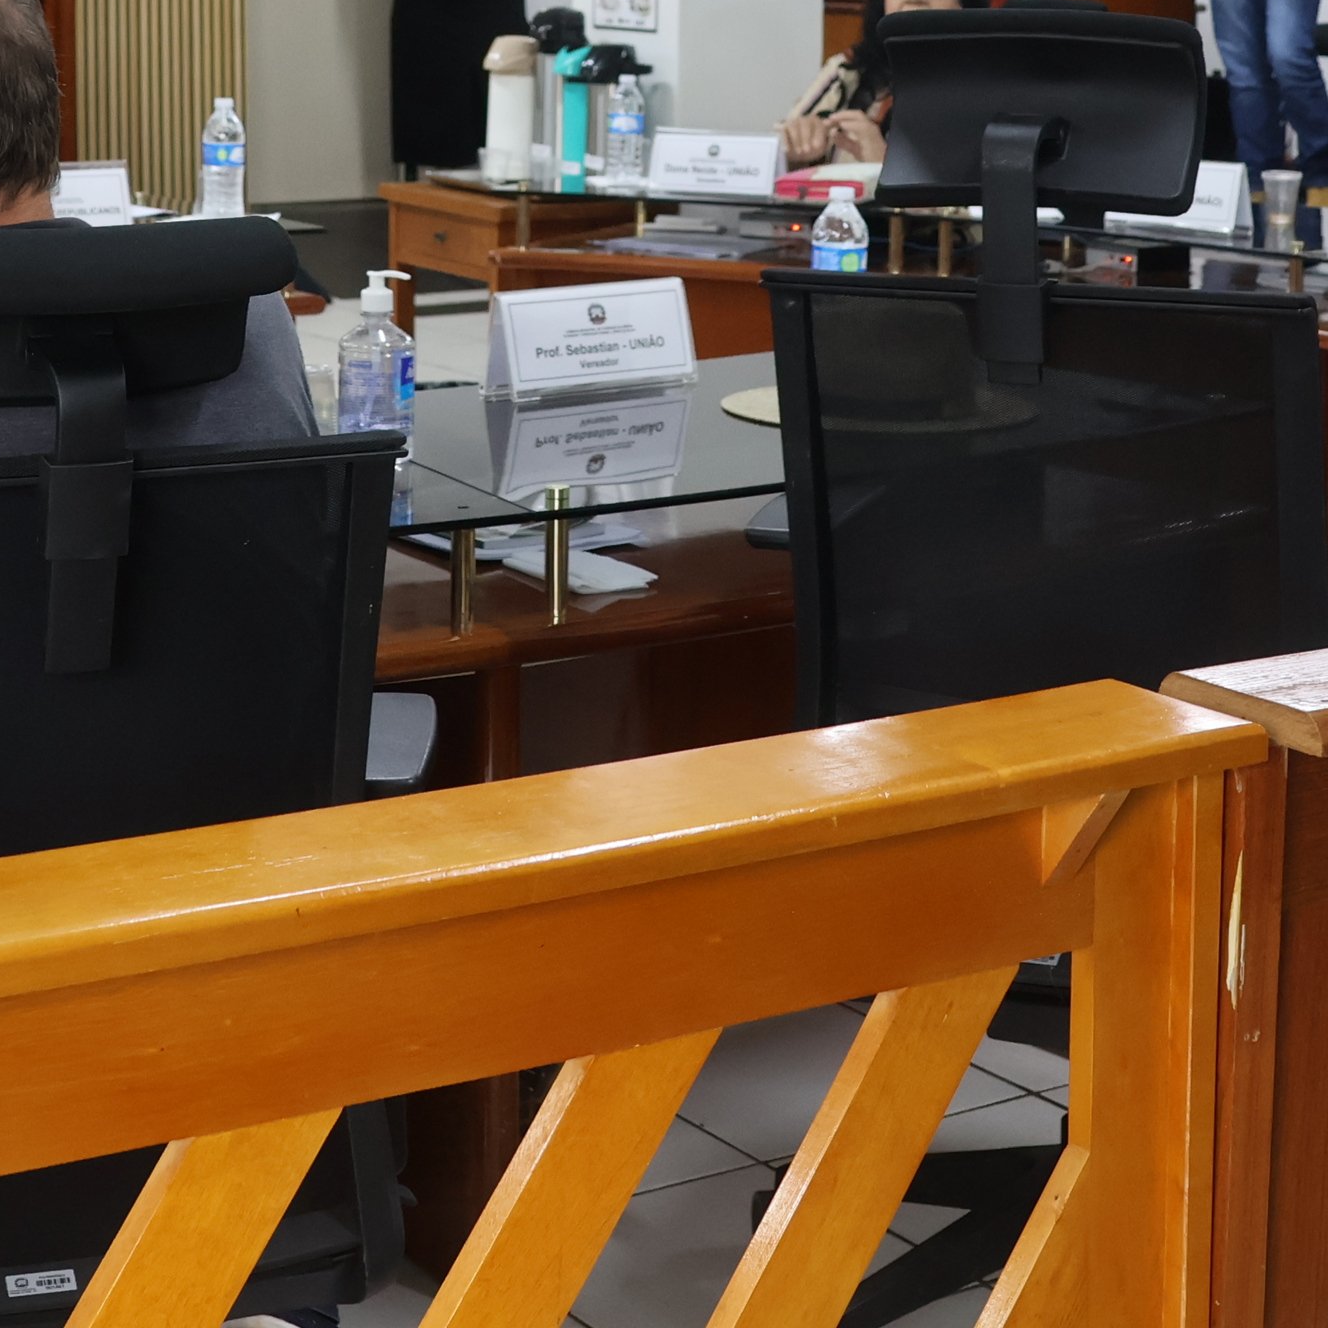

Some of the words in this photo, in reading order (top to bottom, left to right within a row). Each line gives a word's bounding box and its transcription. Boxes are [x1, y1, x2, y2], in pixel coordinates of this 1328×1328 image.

[535, 346, 564, 359] Prof.
[565, 341, 620, 357] Sebastian
[628, 334, 666, 351] UNIÃO
[579, 358, 619, 369] Vereador
